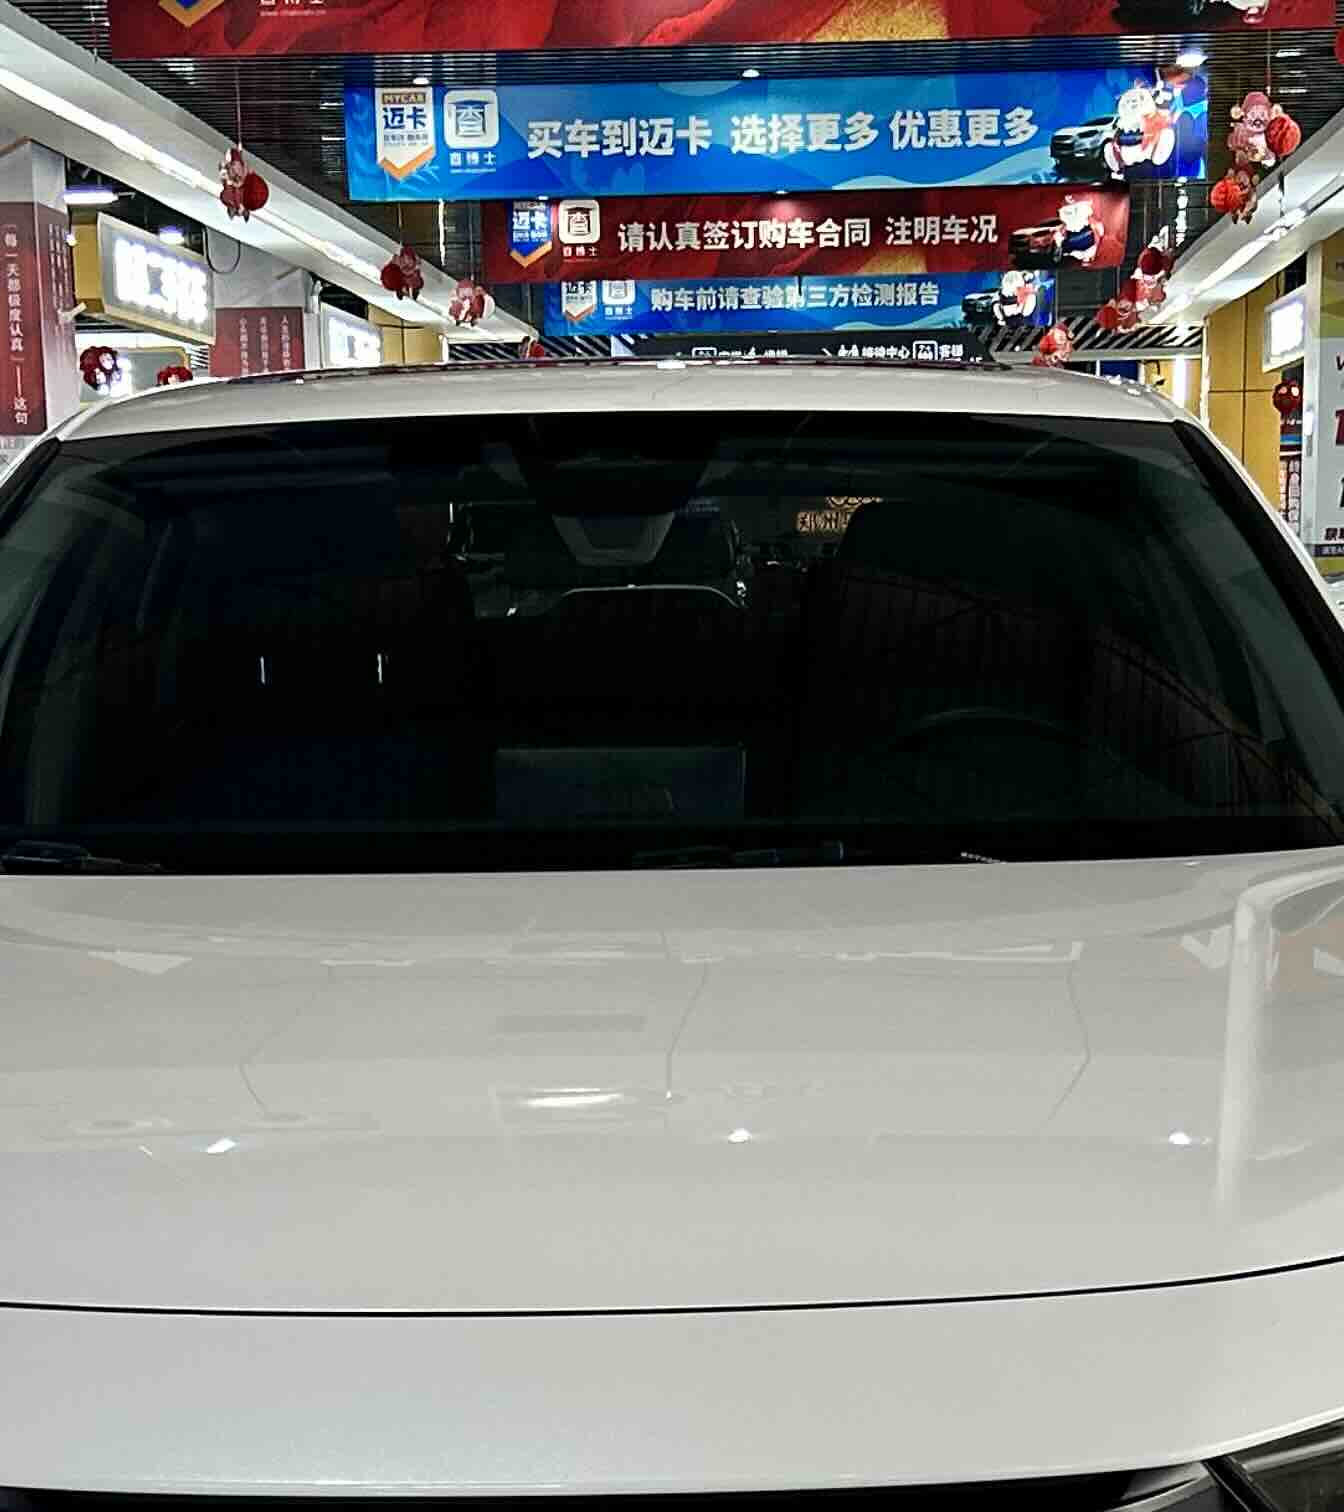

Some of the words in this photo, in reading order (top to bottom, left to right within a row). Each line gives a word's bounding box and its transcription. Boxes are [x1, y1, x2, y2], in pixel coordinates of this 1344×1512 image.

[383, 107, 426, 129] 迈卡
[528, 115, 712, 159] 买车到迈卡
[731, 112, 879, 154] 选择更多
[889, 107, 1039, 150] 优惠更多
[617, 218, 871, 252] 请认真签订购车合同
[885, 215, 998, 245] 注明车况
[651, 280, 939, 312] 购车前请查验第三方检测报告
